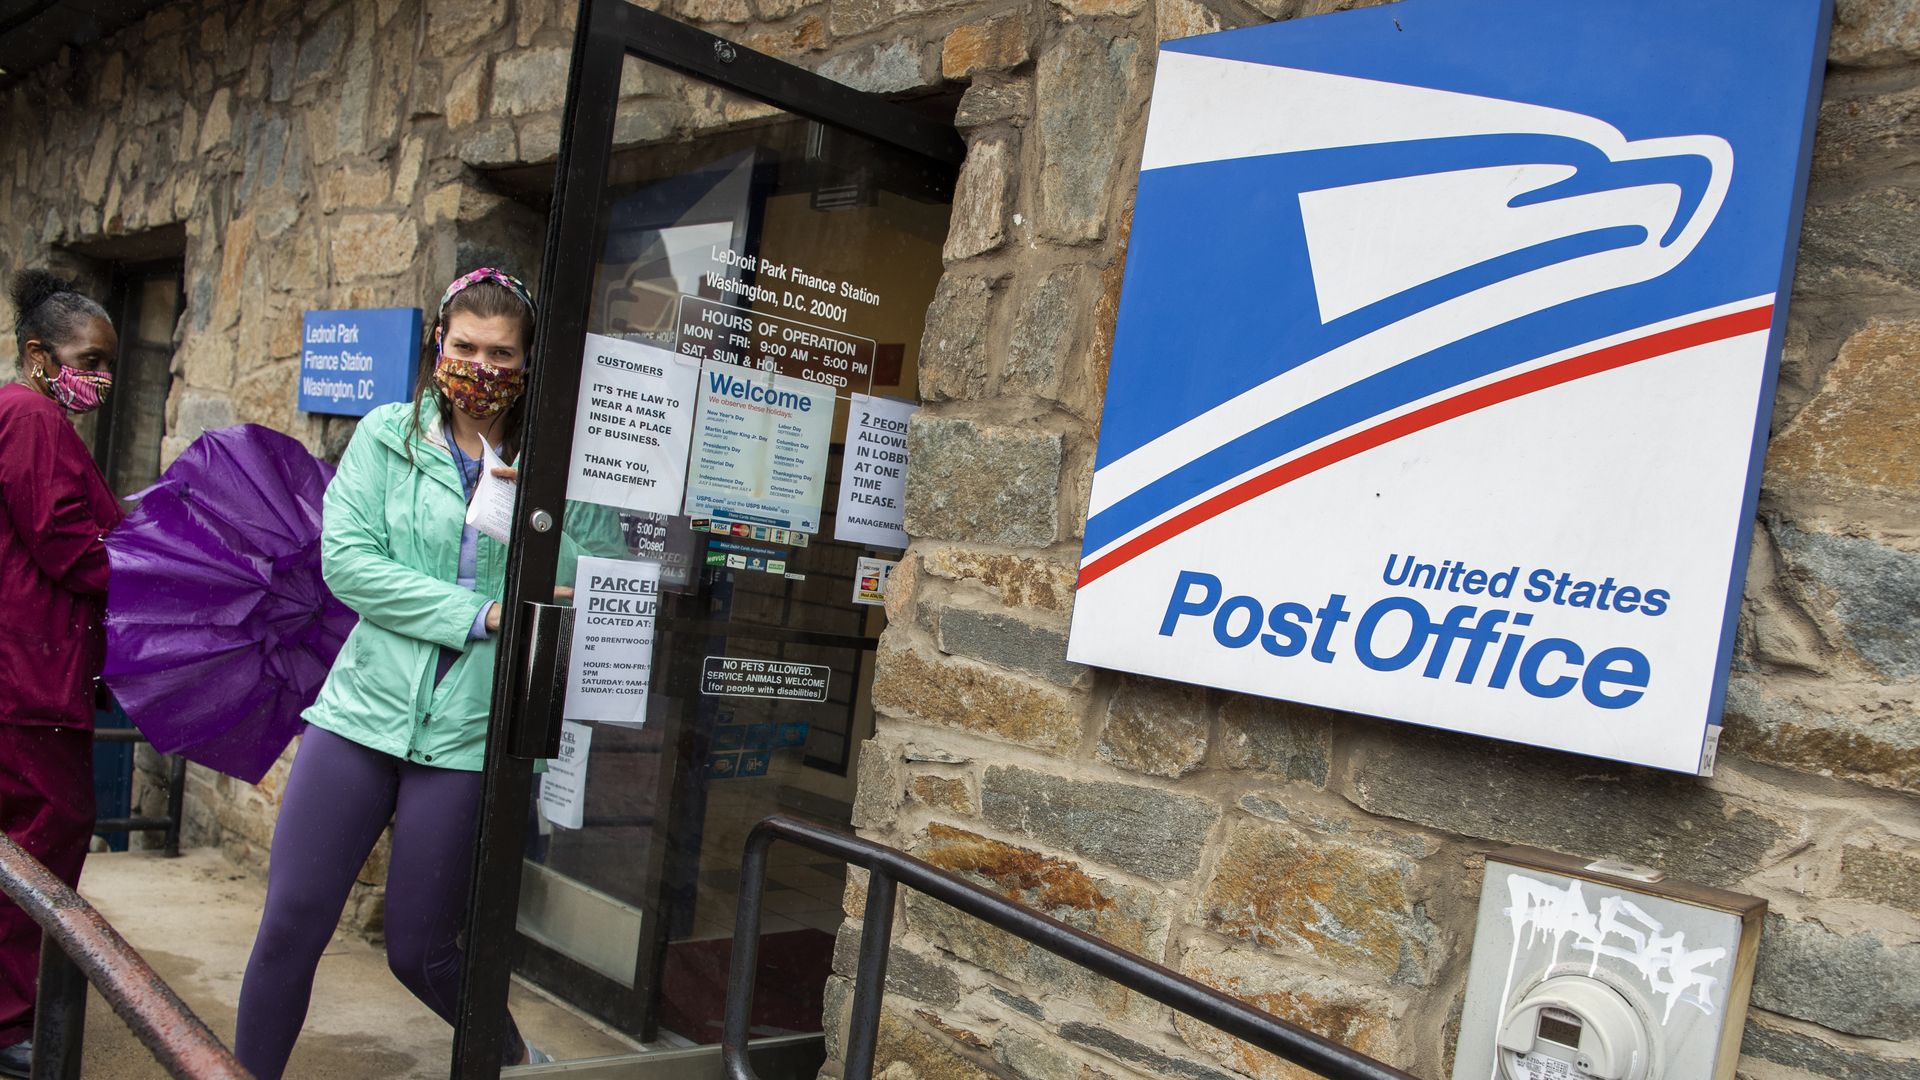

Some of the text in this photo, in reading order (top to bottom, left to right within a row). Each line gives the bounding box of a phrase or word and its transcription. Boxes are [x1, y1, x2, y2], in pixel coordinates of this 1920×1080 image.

[711, 245, 880, 306] LeDroit Park Finance Station
[706, 271, 848, 323] Washington, D.C. 20001
[306, 323, 360, 344] Ledroit Park
[702, 309, 857, 357] HOURS OF OPERATION
[683, 324, 713, 340] MON
[729, 334, 751, 349] FRI:
[760, 341, 787, 357] 9:00
[790, 350, 809, 362] AM
[822, 355, 848, 370] 5:00
[852, 362, 868, 375] PM
[304, 350, 373, 371] Finance Station
[597, 355, 663, 377] CUSTOMERS
[712, 350, 738, 365] SUN
[743, 356, 752, 368] &
[756, 358, 784, 375] HOL:
[802, 369, 848, 388] CLOSED
[303, 377, 374, 402] Washington, DC
[593, 383, 680, 408] IT'S THE LAW TO
[709, 371, 812, 412] Welcome
[591, 397, 666, 419] WEAR A MASK
[708, 395, 719, 404] We
[721, 398, 747, 409] observe
[748, 403, 765, 413] these
[589, 411, 672, 435] INSIDE A PLACE
[720, 411, 734, 419] Year's
[860, 412, 908, 434] 2 PEOPL
[588, 426, 660, 447] OF BUSINESS.
[705, 425, 721, 433] Martin
[703, 441, 731, 451] President's
[776, 438, 810, 450] Columbus Day
[858, 431, 908, 450] ALLOWE
[585, 454, 649, 474] THANK YOU,
[701, 457, 724, 466] Memorial
[774, 454, 794, 463] Veterans
[857, 446, 909, 465] IN LOBBY
[582, 468, 657, 488] MANAGEMENT
[699, 474, 733, 484] Independence
[773, 469, 812, 482] Thanksgiving Day
[854, 461, 900, 479] AT ONE
[770, 485, 804, 496] Christmas Day
[853, 476, 882, 491] TIME
[851, 492, 897, 509] PLEASE.
[637, 522, 666, 538] 5:00 pm
[714, 523, 727, 531] VISA
[639, 537, 665, 552] Closed
[590, 575, 658, 594] PARCEL
[1383, 553, 1671, 617] United States
[588, 597, 656, 614] PICK UP
[587, 617, 652, 628] LOCATED AT:
[600, 637, 650, 645] BRENTWOOD
[1158, 570, 1652, 710] Post Office
[583, 661, 612, 669] HOURS:
[612, 662, 646, 671] MON-FRI:
[722, 660, 813, 676] NO PETS ALLOWED.
[581, 678, 625, 686] SATURDAY:
[707, 671, 825, 687] SERVICE ANIMALS WELCOME
[581, 686, 644, 695] SUNDAY: CLOSED
[708, 682, 821, 699] (for people with disabilities)
